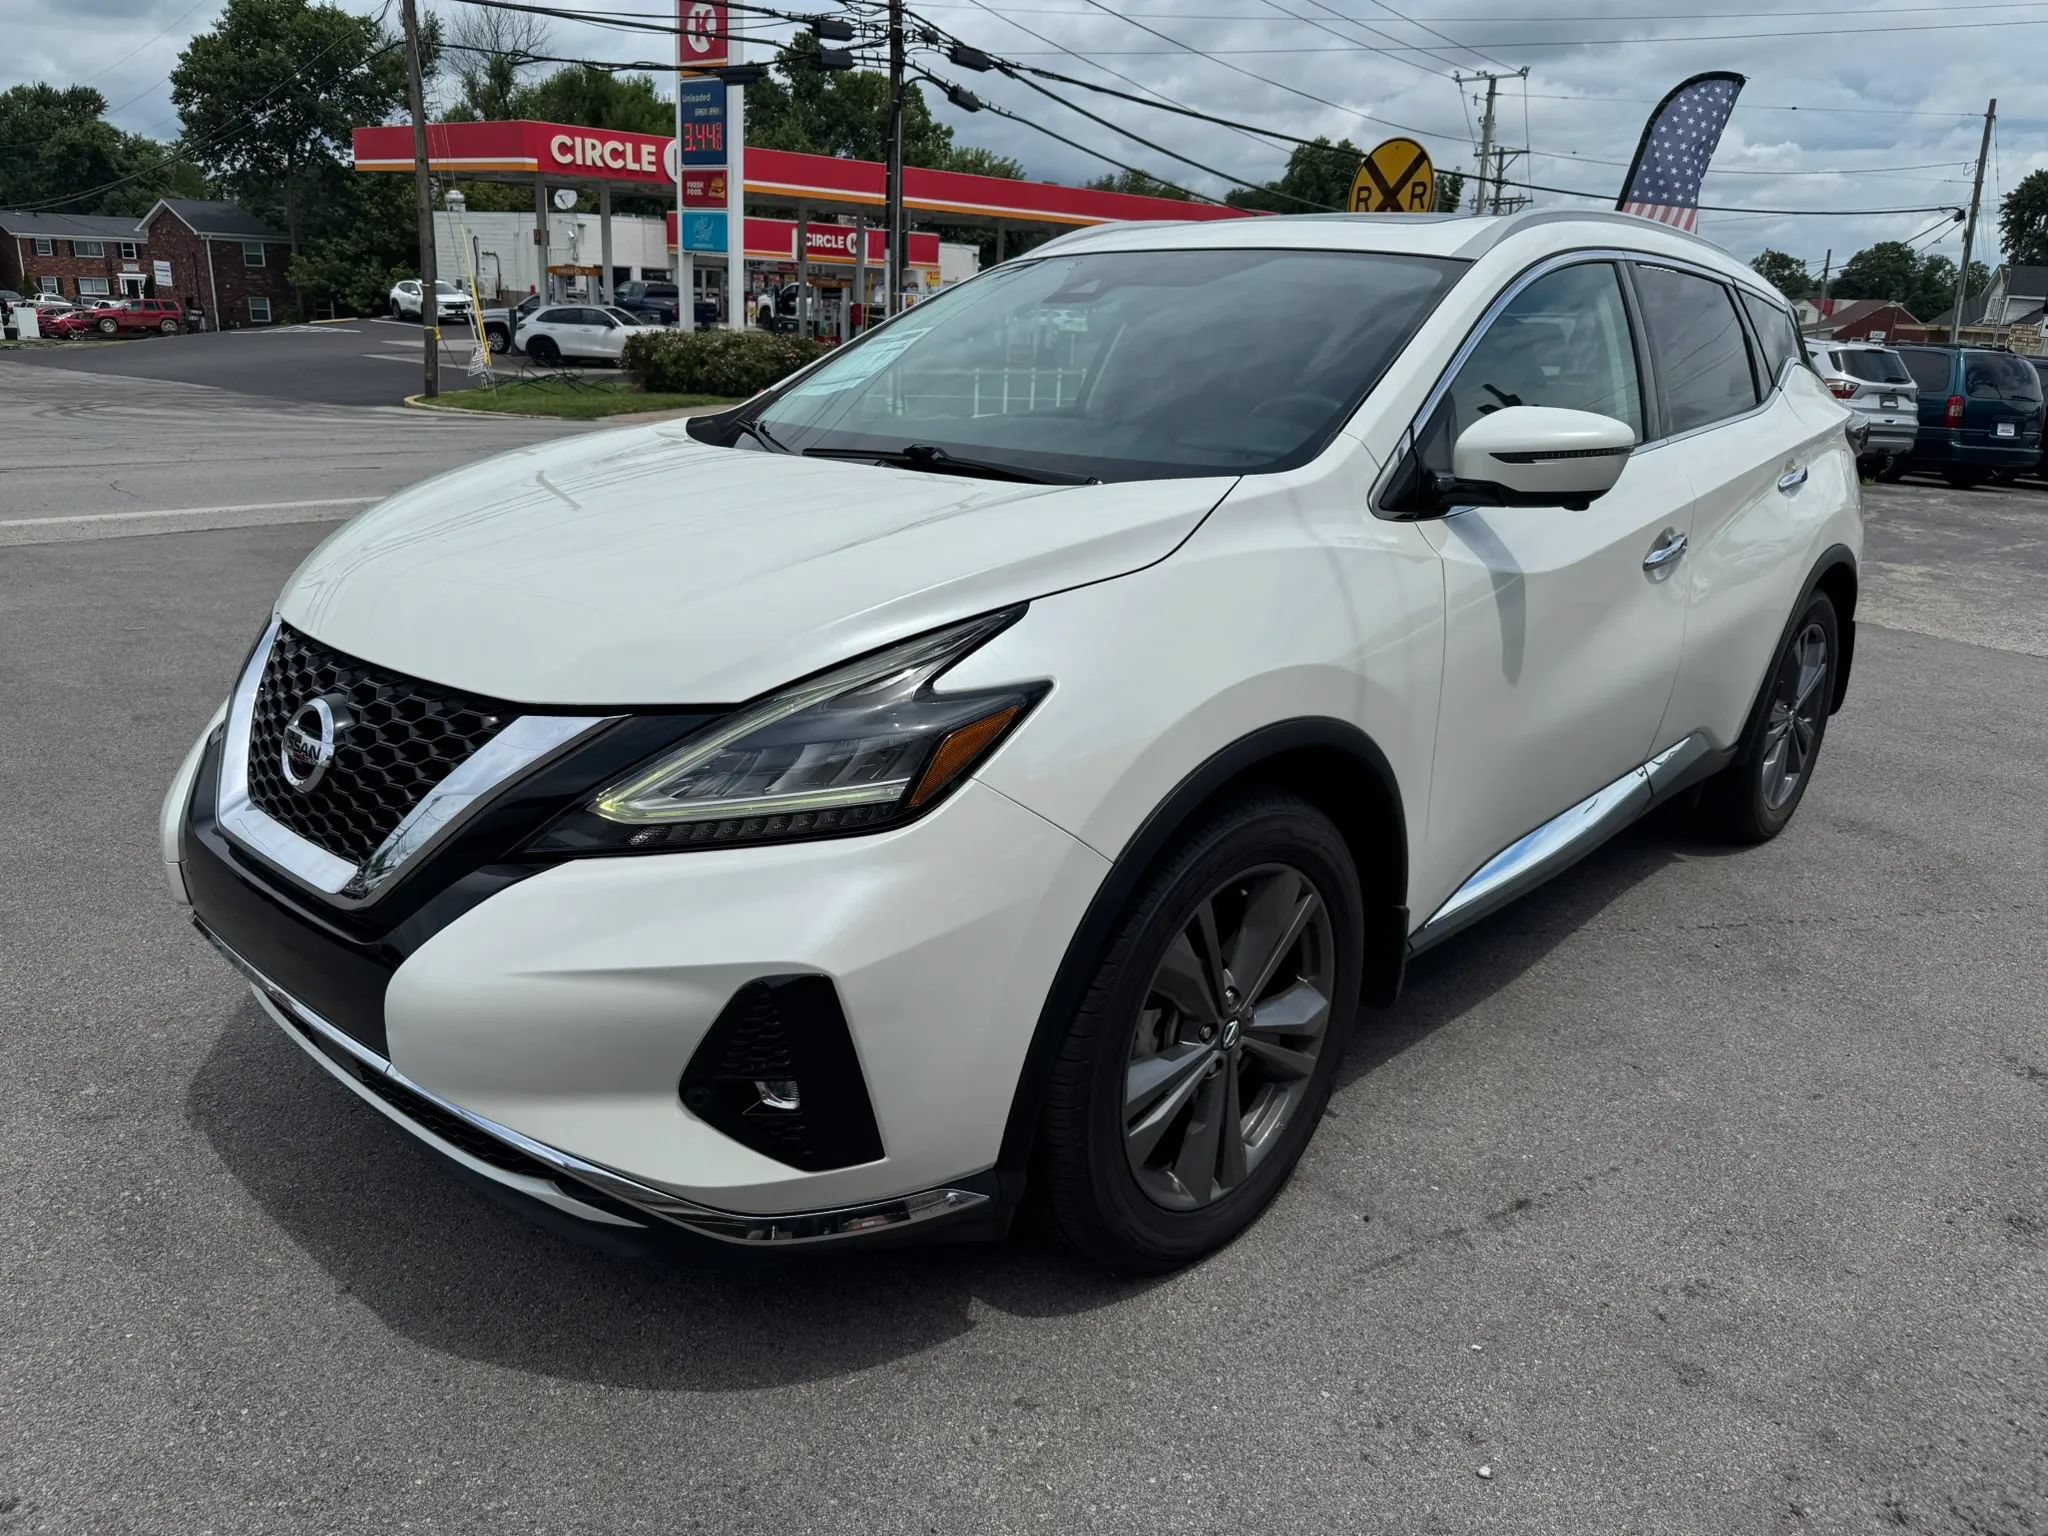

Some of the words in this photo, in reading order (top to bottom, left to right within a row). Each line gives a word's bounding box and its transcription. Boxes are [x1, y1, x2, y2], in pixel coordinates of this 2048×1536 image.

[682, 92, 711, 103] Unleaded
[551, 135, 656, 172] CIRCLE
[806, 233, 845, 248] CIRCLE
